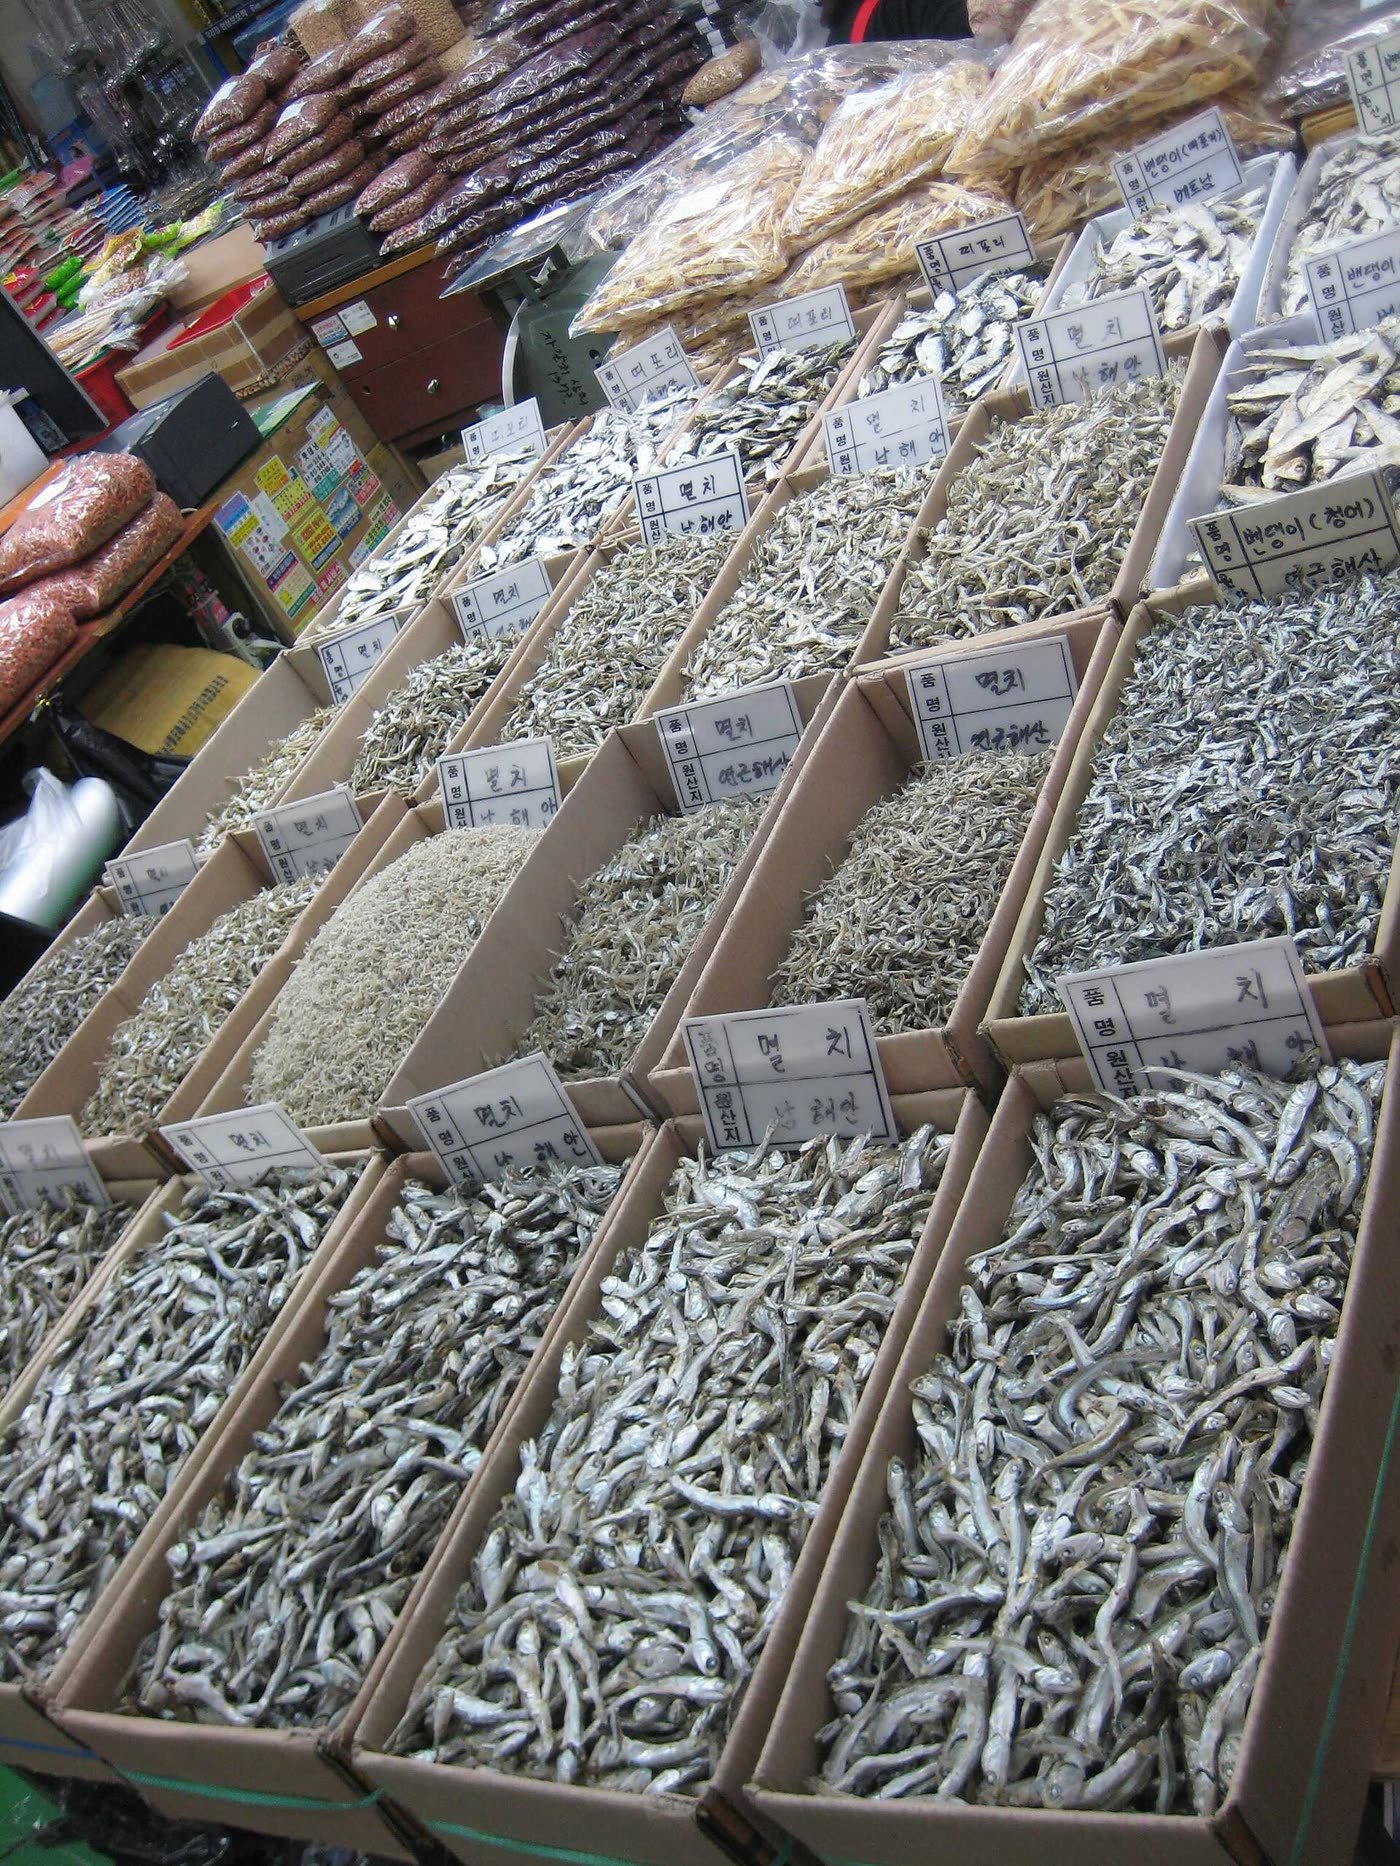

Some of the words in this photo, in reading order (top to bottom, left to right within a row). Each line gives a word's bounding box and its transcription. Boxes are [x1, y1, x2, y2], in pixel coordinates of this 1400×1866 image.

[1173, 172, 1215, 203] 베트남
[1316, 263, 1336, 300] 품명
[1027, 327, 1045, 361] 품명
[1038, 369, 1055, 404] 원산지
[643, 483, 656, 512] 품명
[679, 474, 717, 501] 멸치
[920, 672, 941, 712] 품명
[975, 667, 1026, 696] 멸치
[668, 718, 688, 754] 품명
[714, 714, 753, 741] 멸치
[447, 764, 462, 799] 품명
[485, 764, 527, 793] 멸치
[682, 763, 703, 802] 원산지
[1082, 986, 1116, 1038] 품명
[425, 1106, 454, 1147] 품명
[473, 1096, 524, 1128] 멸치
[715, 1091, 742, 1143] 원산지
[228, 1129, 272, 1152] 멸치
